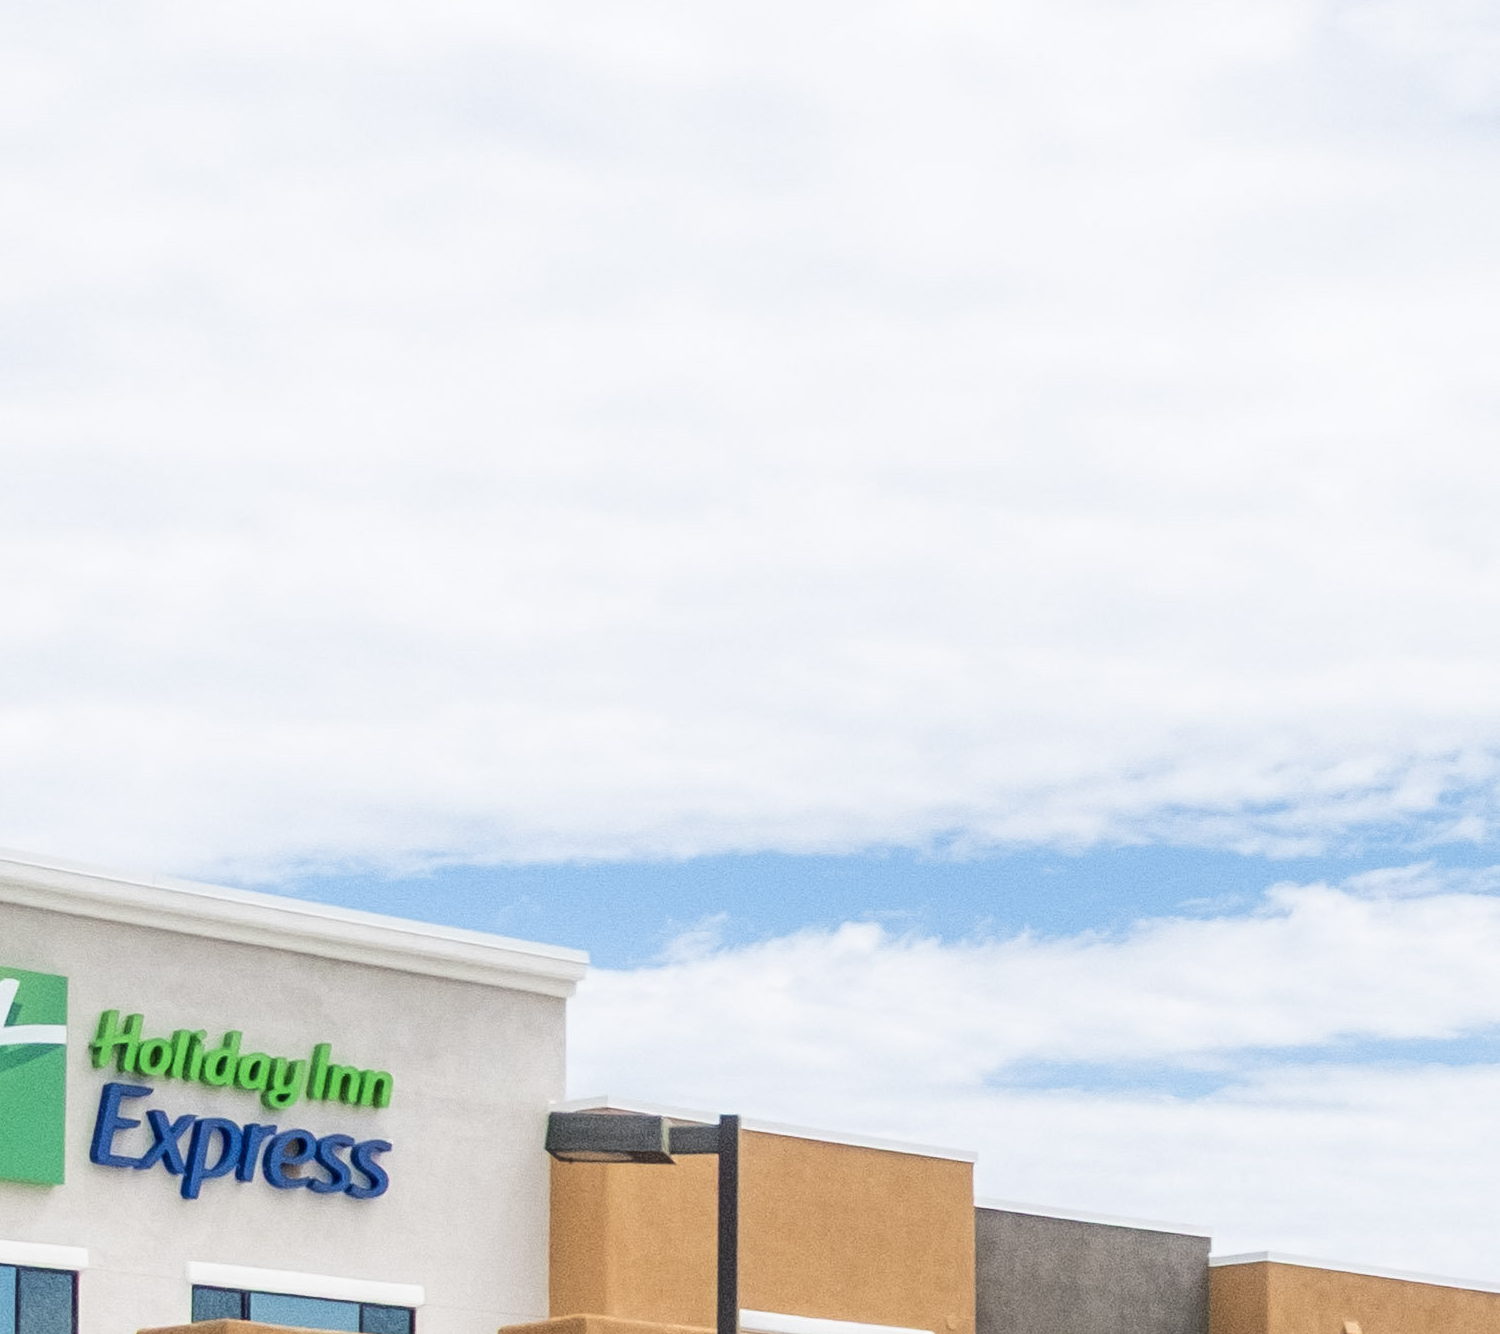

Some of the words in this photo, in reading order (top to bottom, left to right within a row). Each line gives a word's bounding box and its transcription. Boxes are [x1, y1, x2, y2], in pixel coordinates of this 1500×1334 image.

[90, 1010, 306, 1110] Holiday
[306, 1043, 393, 1108] Inn
[89, 1082, 392, 1199] Express
